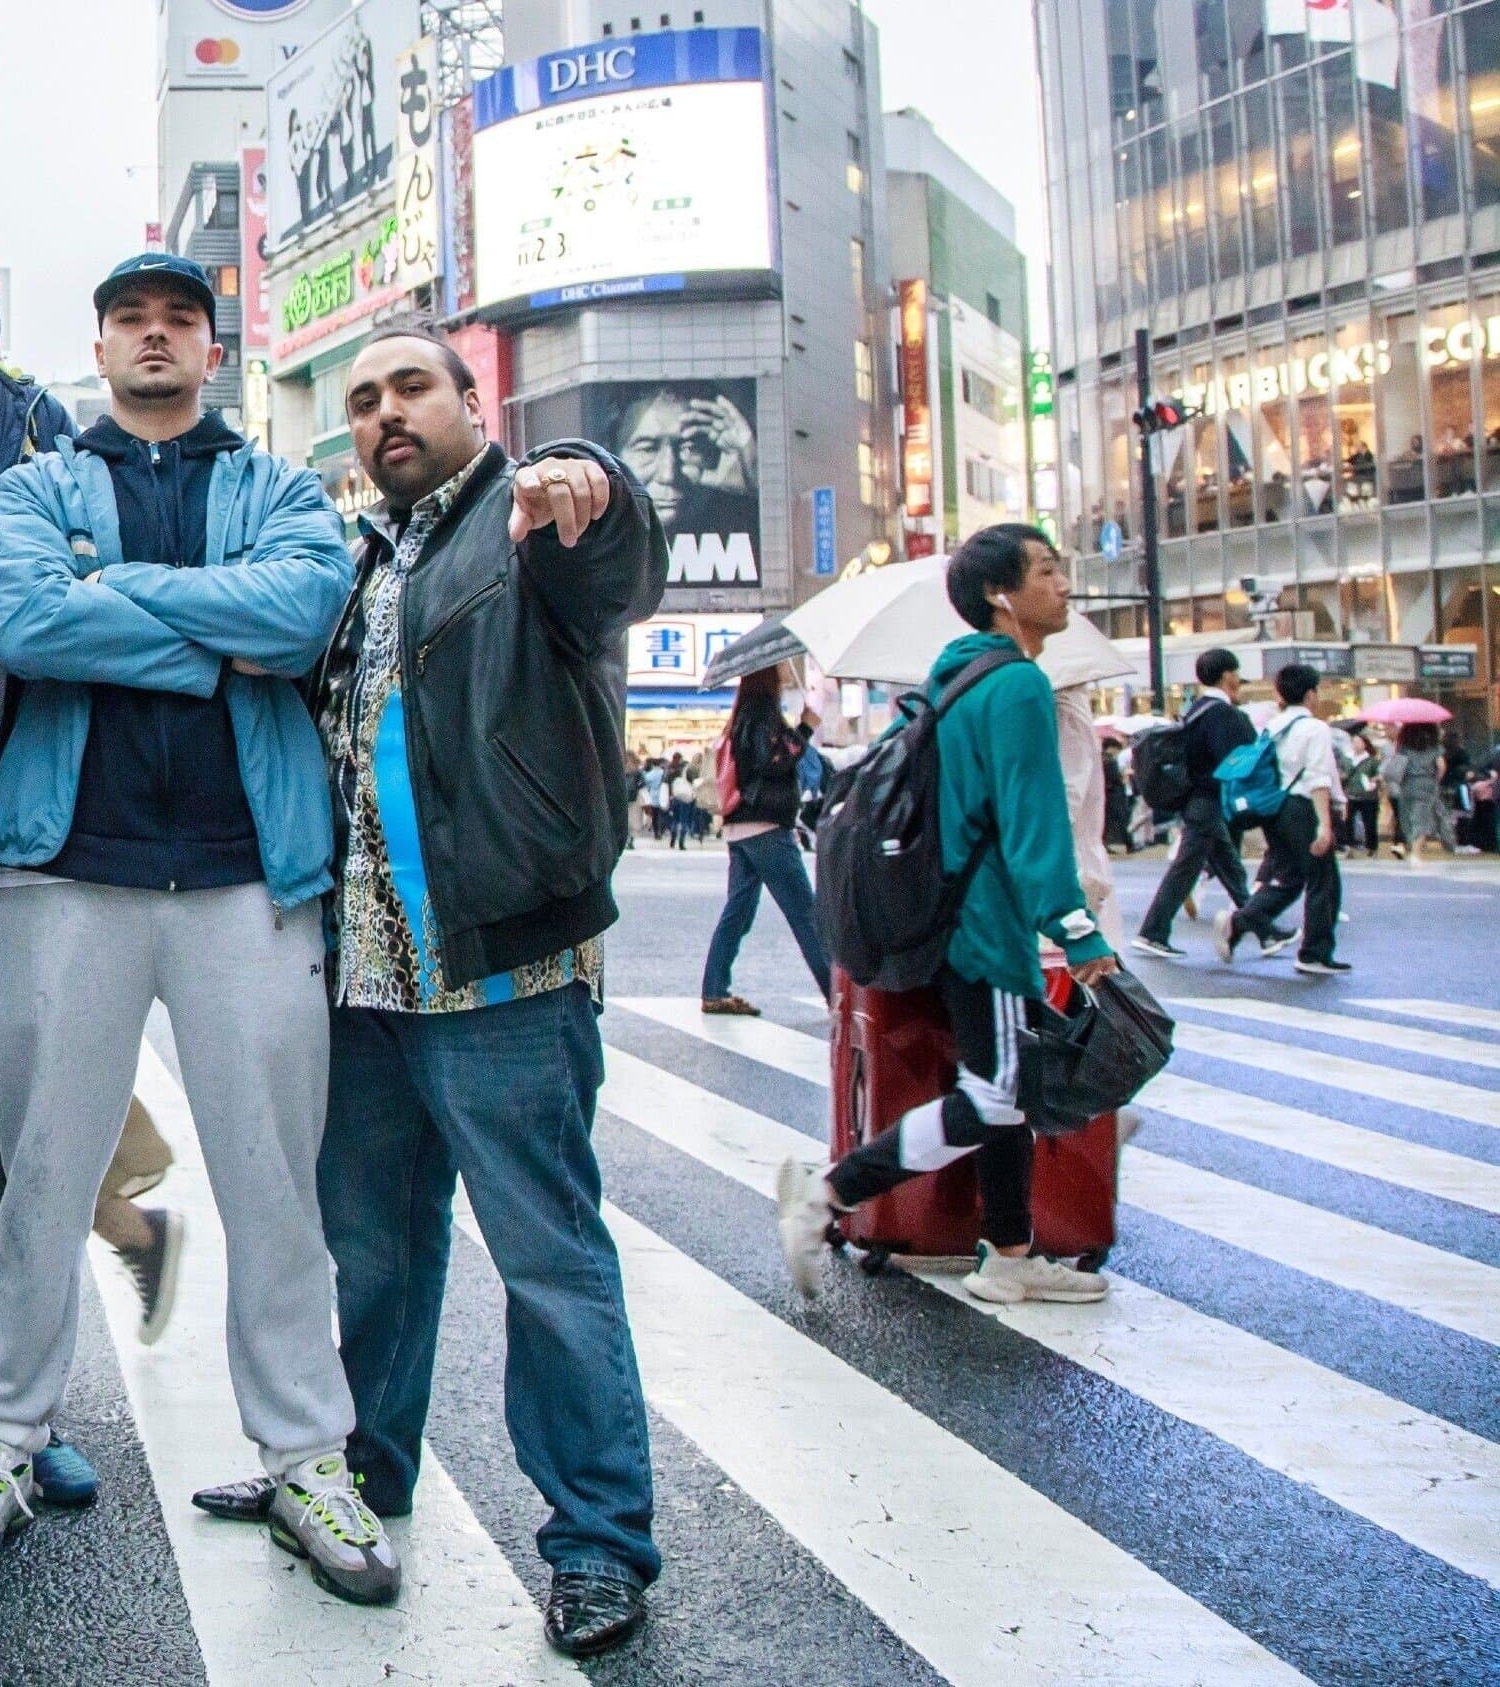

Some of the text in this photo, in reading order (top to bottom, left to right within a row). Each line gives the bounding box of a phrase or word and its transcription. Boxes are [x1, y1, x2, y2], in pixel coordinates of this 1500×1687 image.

[549, 46, 636, 93] DHC
[400, 53, 436, 274] もんじゃ
